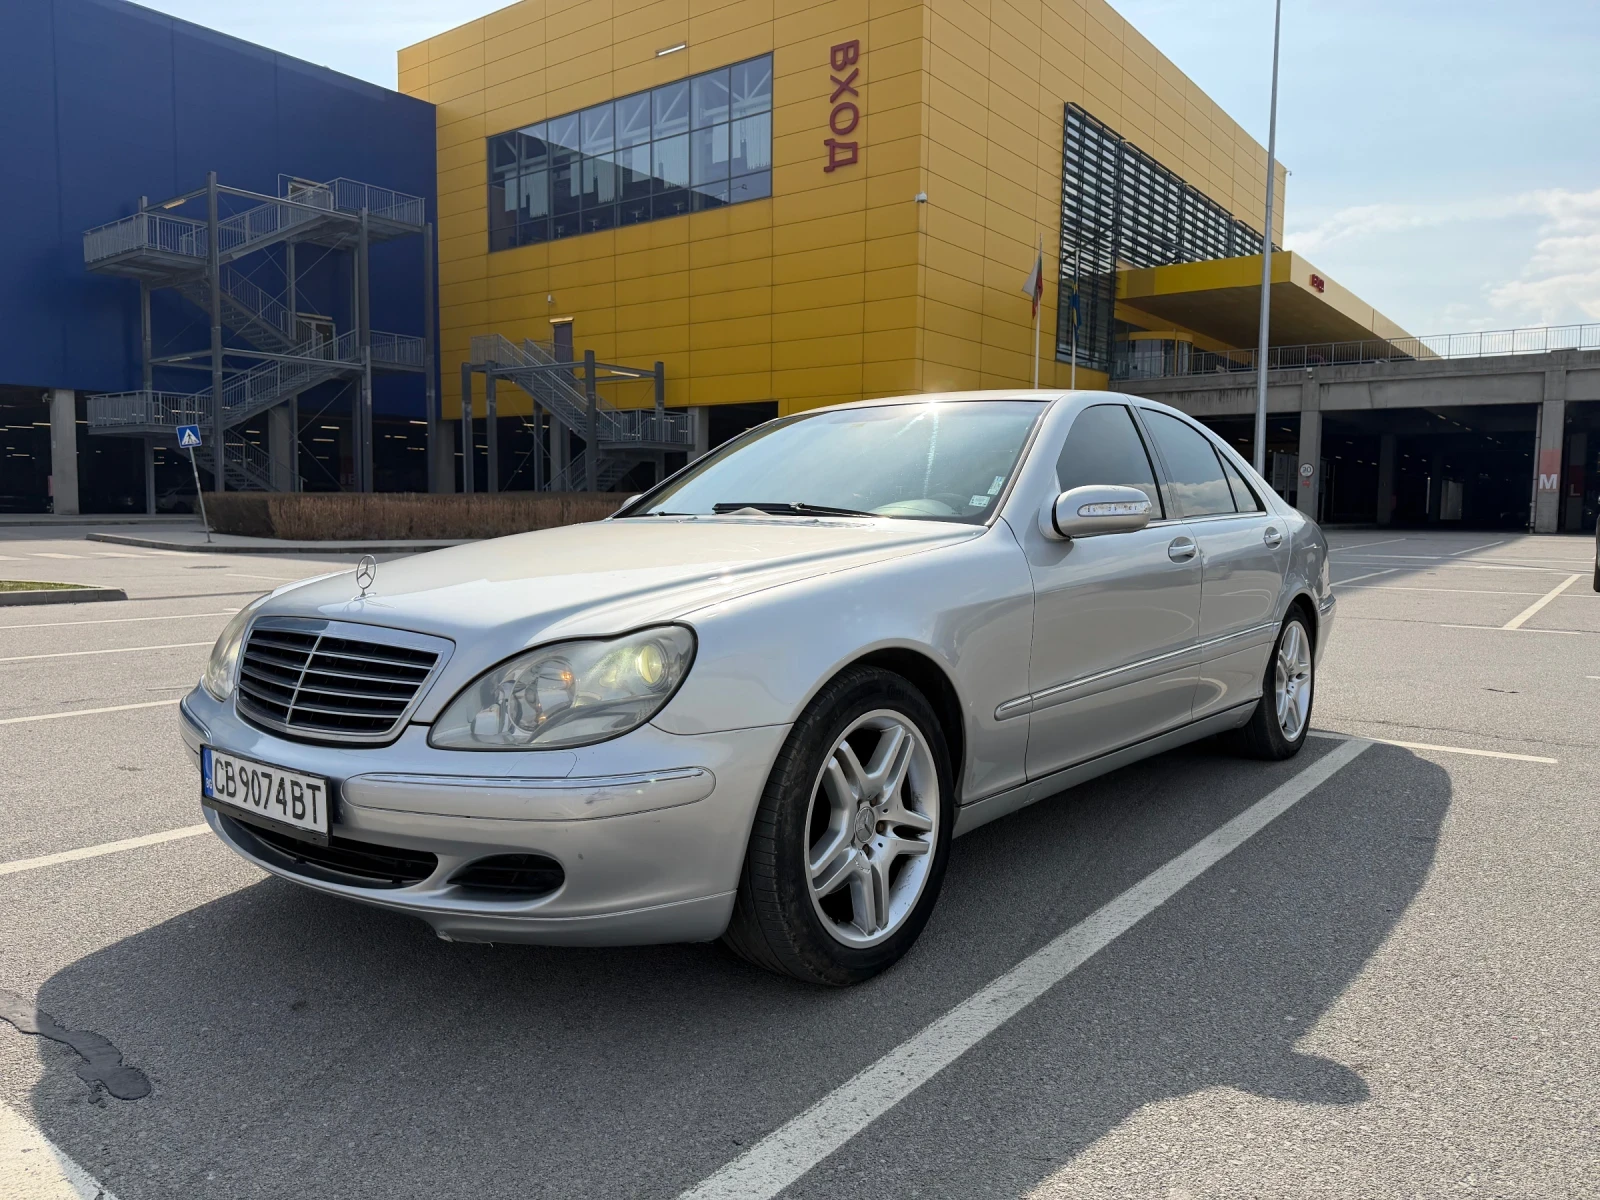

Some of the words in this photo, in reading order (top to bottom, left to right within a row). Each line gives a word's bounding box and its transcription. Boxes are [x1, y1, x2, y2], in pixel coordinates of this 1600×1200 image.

[823, 39, 860, 173] ВХОД
[1540, 473, 1558, 490] M
[1569, 483, 1581, 496] L
[214, 757, 321, 825] CB9074BT
